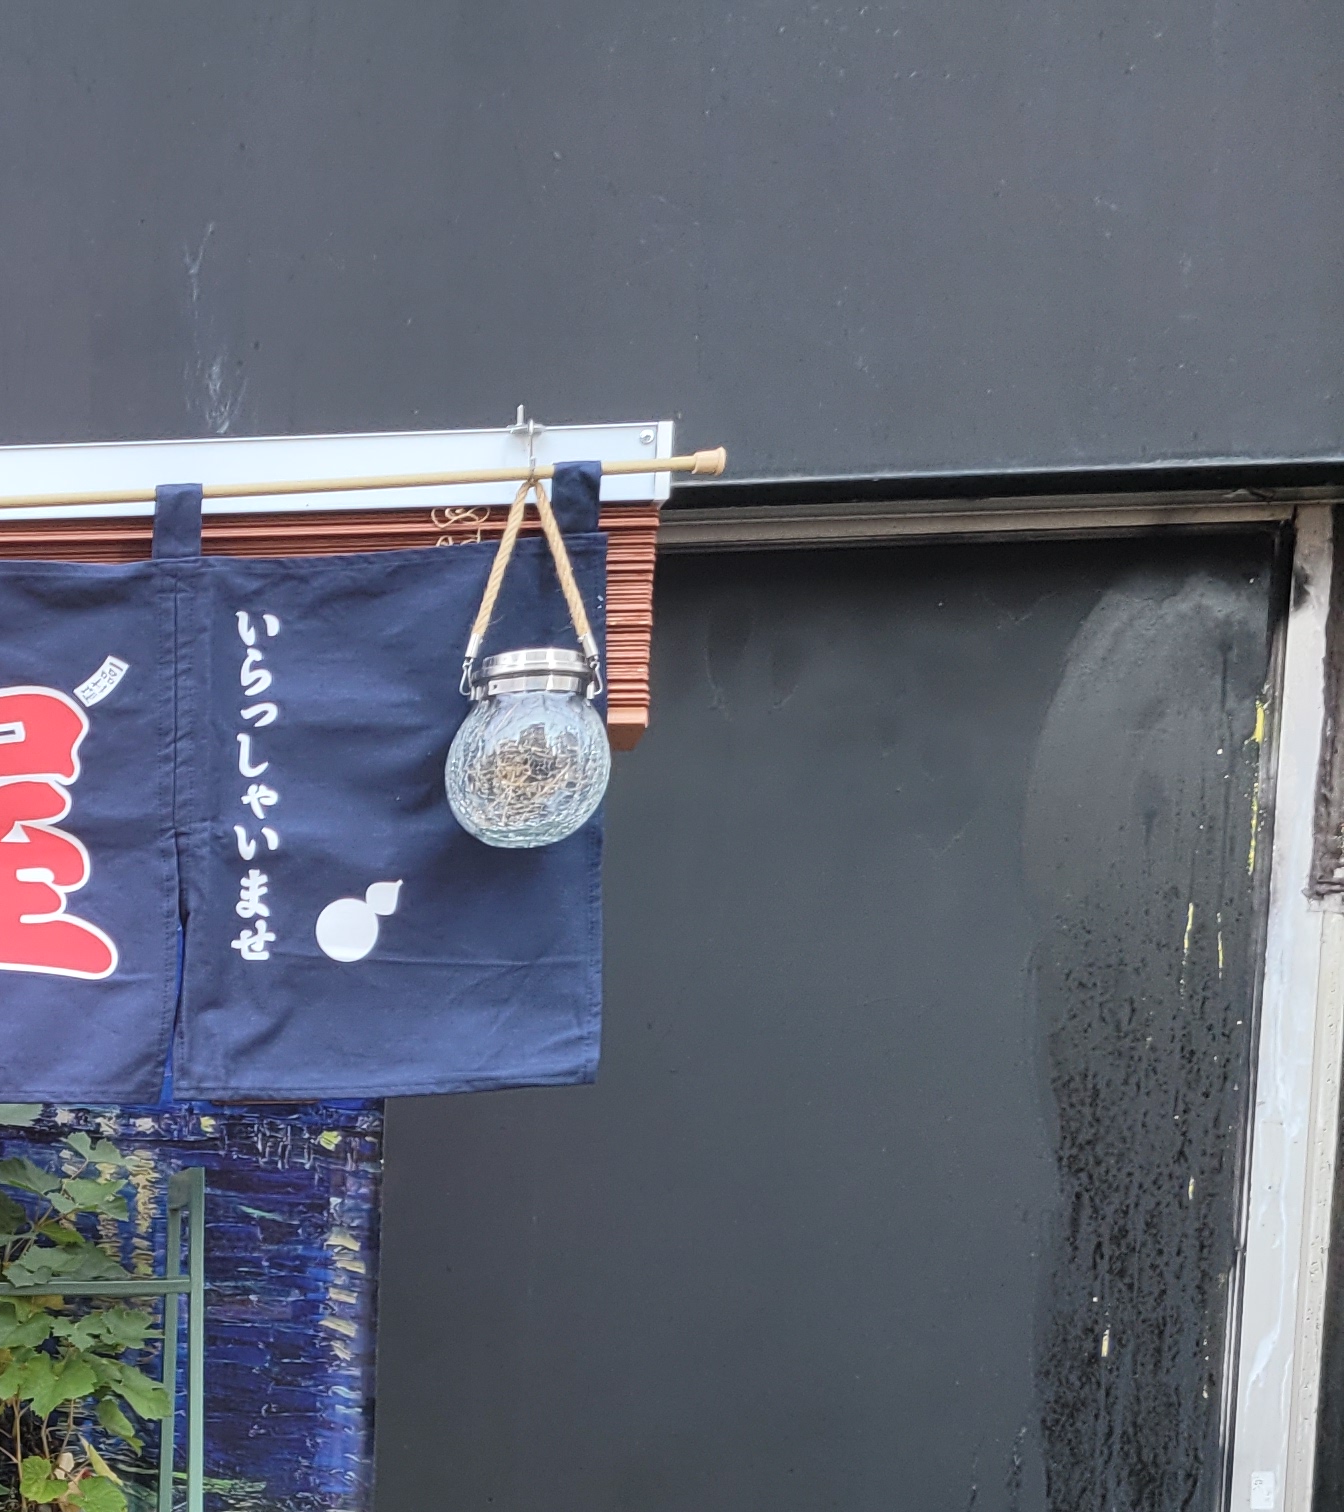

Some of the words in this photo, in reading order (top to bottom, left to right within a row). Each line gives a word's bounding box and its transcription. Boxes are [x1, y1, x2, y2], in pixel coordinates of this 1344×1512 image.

[230, 610, 280, 962] いらっしゃいませ
